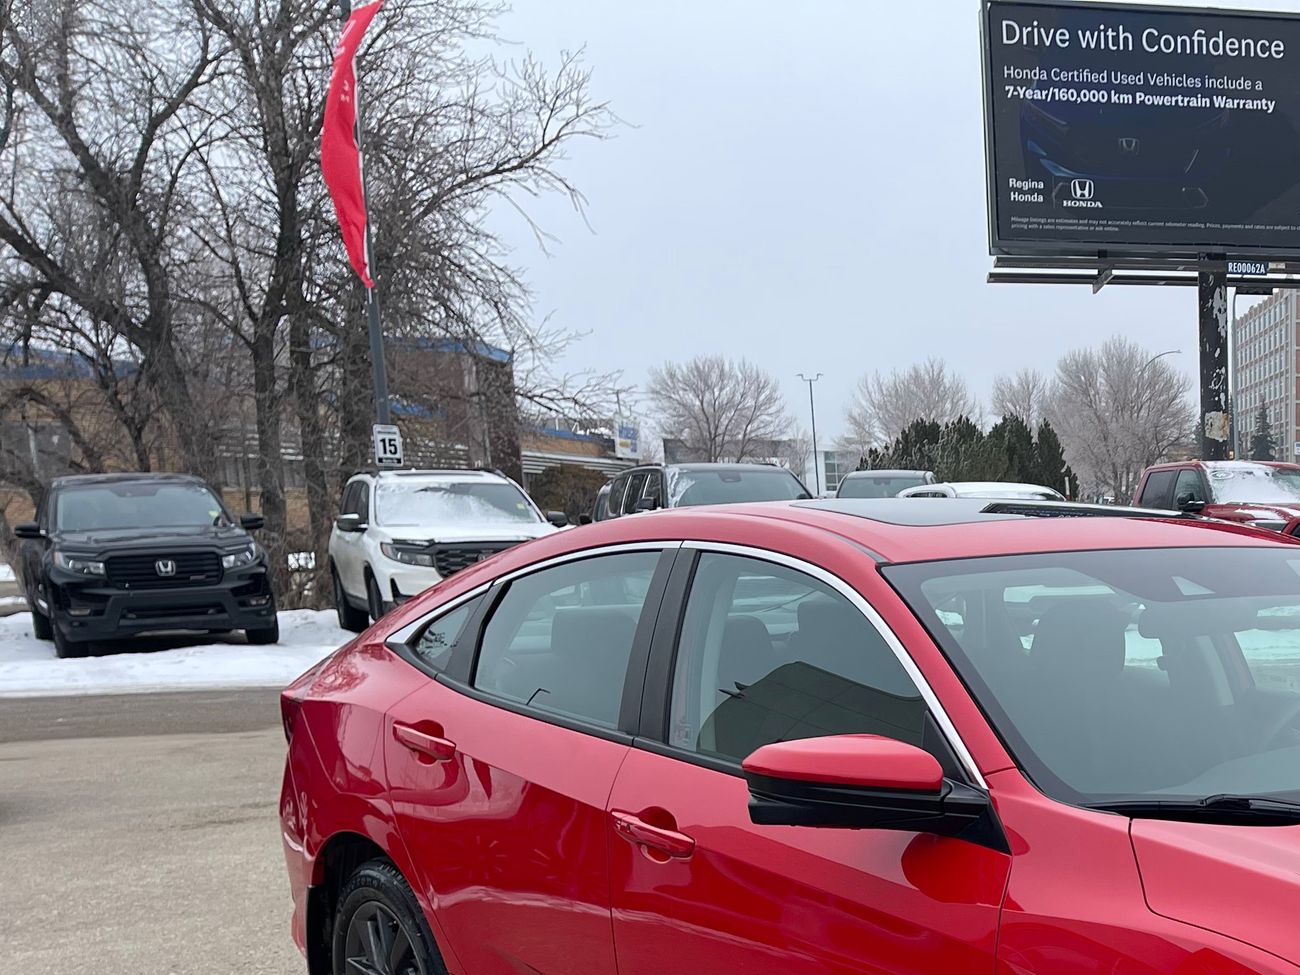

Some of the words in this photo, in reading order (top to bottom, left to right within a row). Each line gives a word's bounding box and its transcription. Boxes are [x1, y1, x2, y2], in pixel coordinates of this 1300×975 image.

[1001, 20, 1070, 48] Drive
[1077, 24, 1133, 51] with
[1141, 28, 1285, 59] Confidence
[1003, 65, 1048, 81] Honda
[1050, 67, 1107, 83] Certified
[1111, 70, 1144, 85] Used
[1147, 72, 1202, 88] Vehicles
[1205, 75, 1252, 91] include
[1254, 80, 1263, 91] a
[1005, 85, 1108, 104] 7-Year/160,000
[1111, 89, 1133, 104] km
[1135, 92, 1210, 108] Powertrain
[1213, 95, 1276, 113] Warranty
[1009, 178, 1044, 191] Regina
[1010, 191, 1044, 203] Honda
[1062, 200, 1103, 208] HONDA
[1228, 262, 1266, 274] RE00062A
[379, 438, 398, 455] 15
